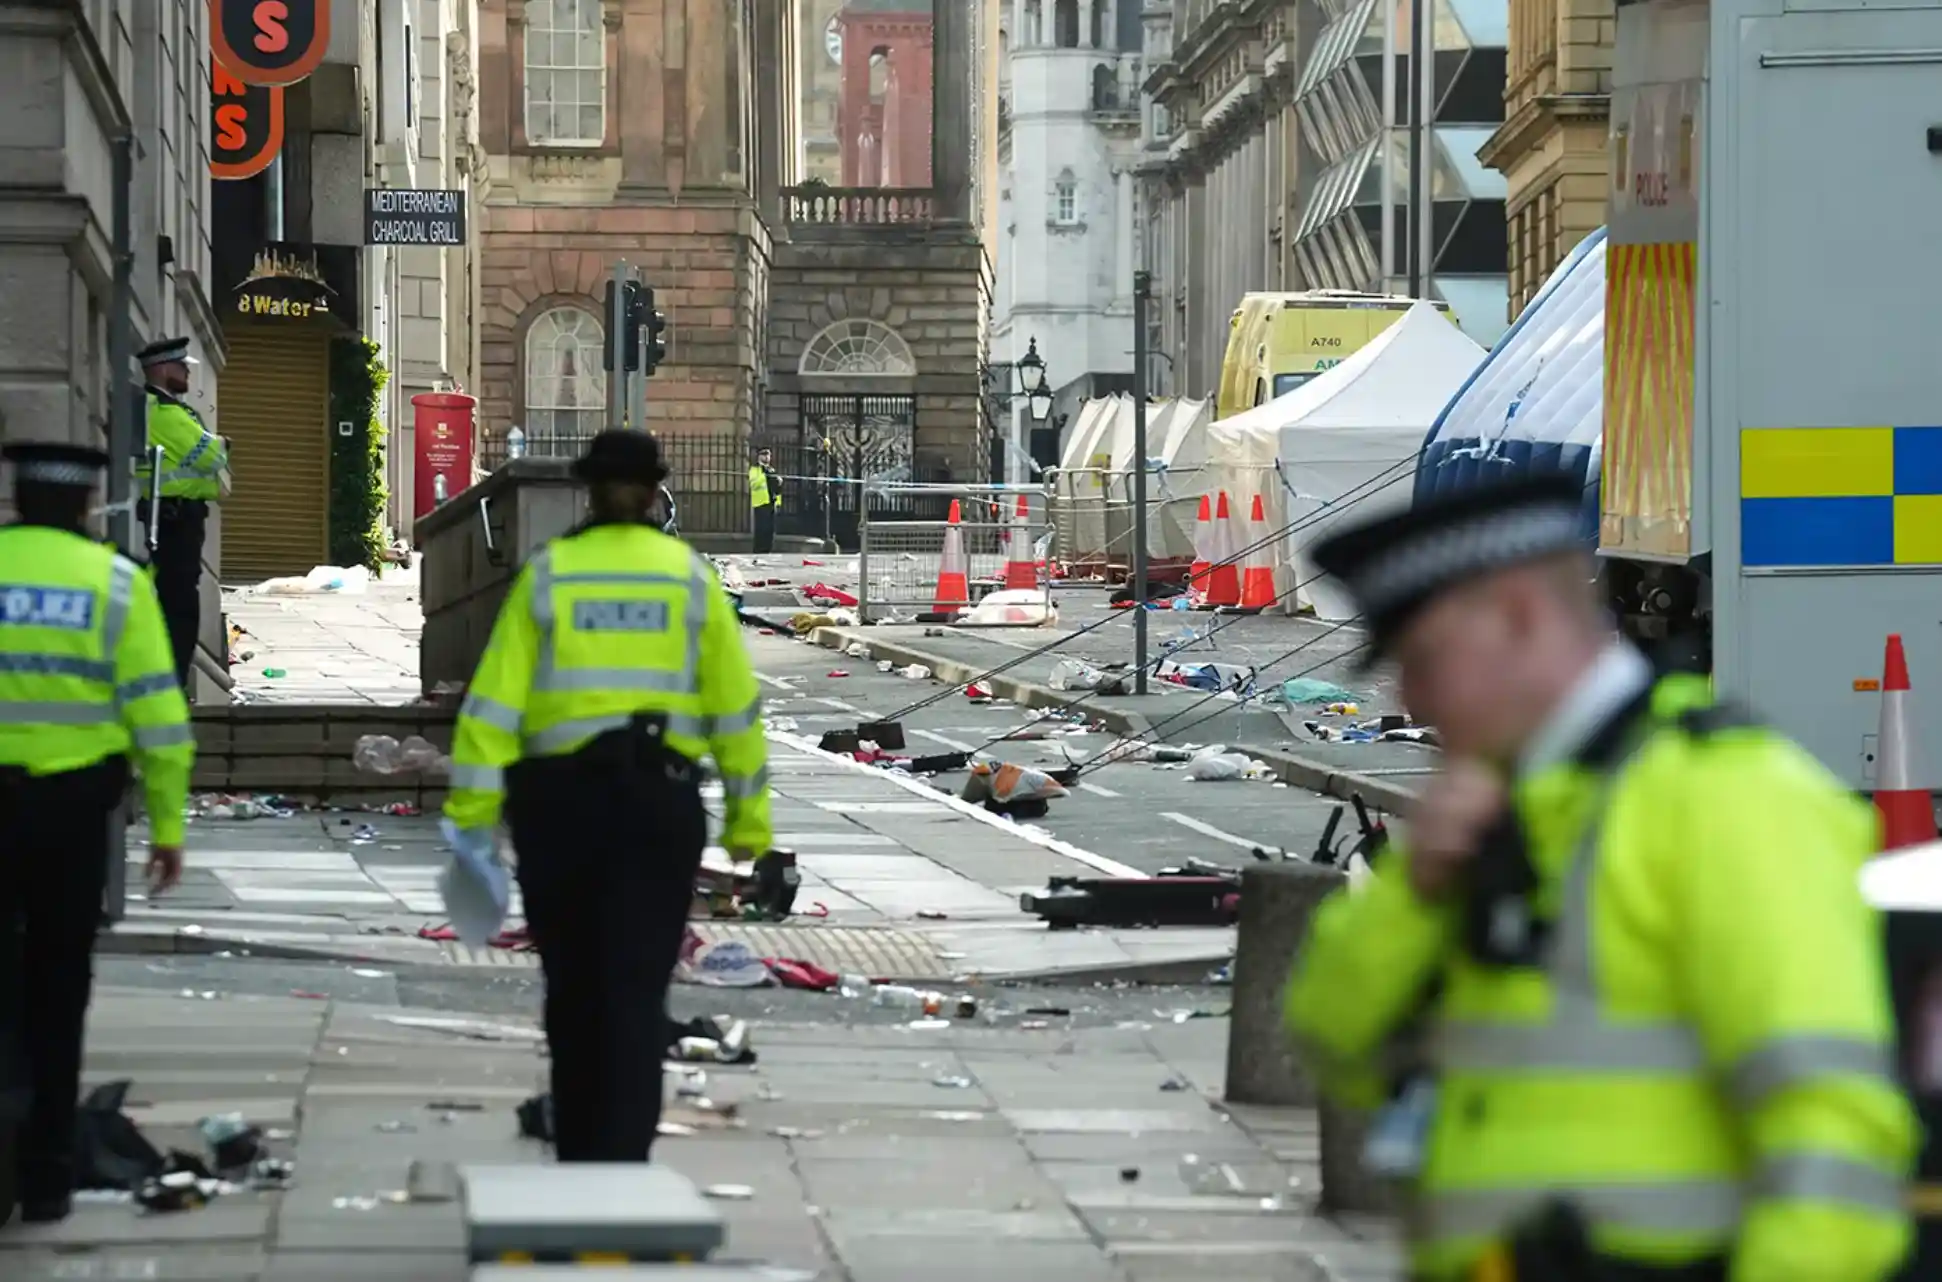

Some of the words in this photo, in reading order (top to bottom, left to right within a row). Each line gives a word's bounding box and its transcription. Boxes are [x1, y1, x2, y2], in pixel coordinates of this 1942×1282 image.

[372, 191, 458, 213] MEDITERRANEAN
[372, 220, 428, 242] CHARCOAL
[430, 221, 459, 242] GRILL
[238, 294, 251, 312] 8
[253, 295, 311, 317] Water
[1311, 337, 1342, 347] A740
